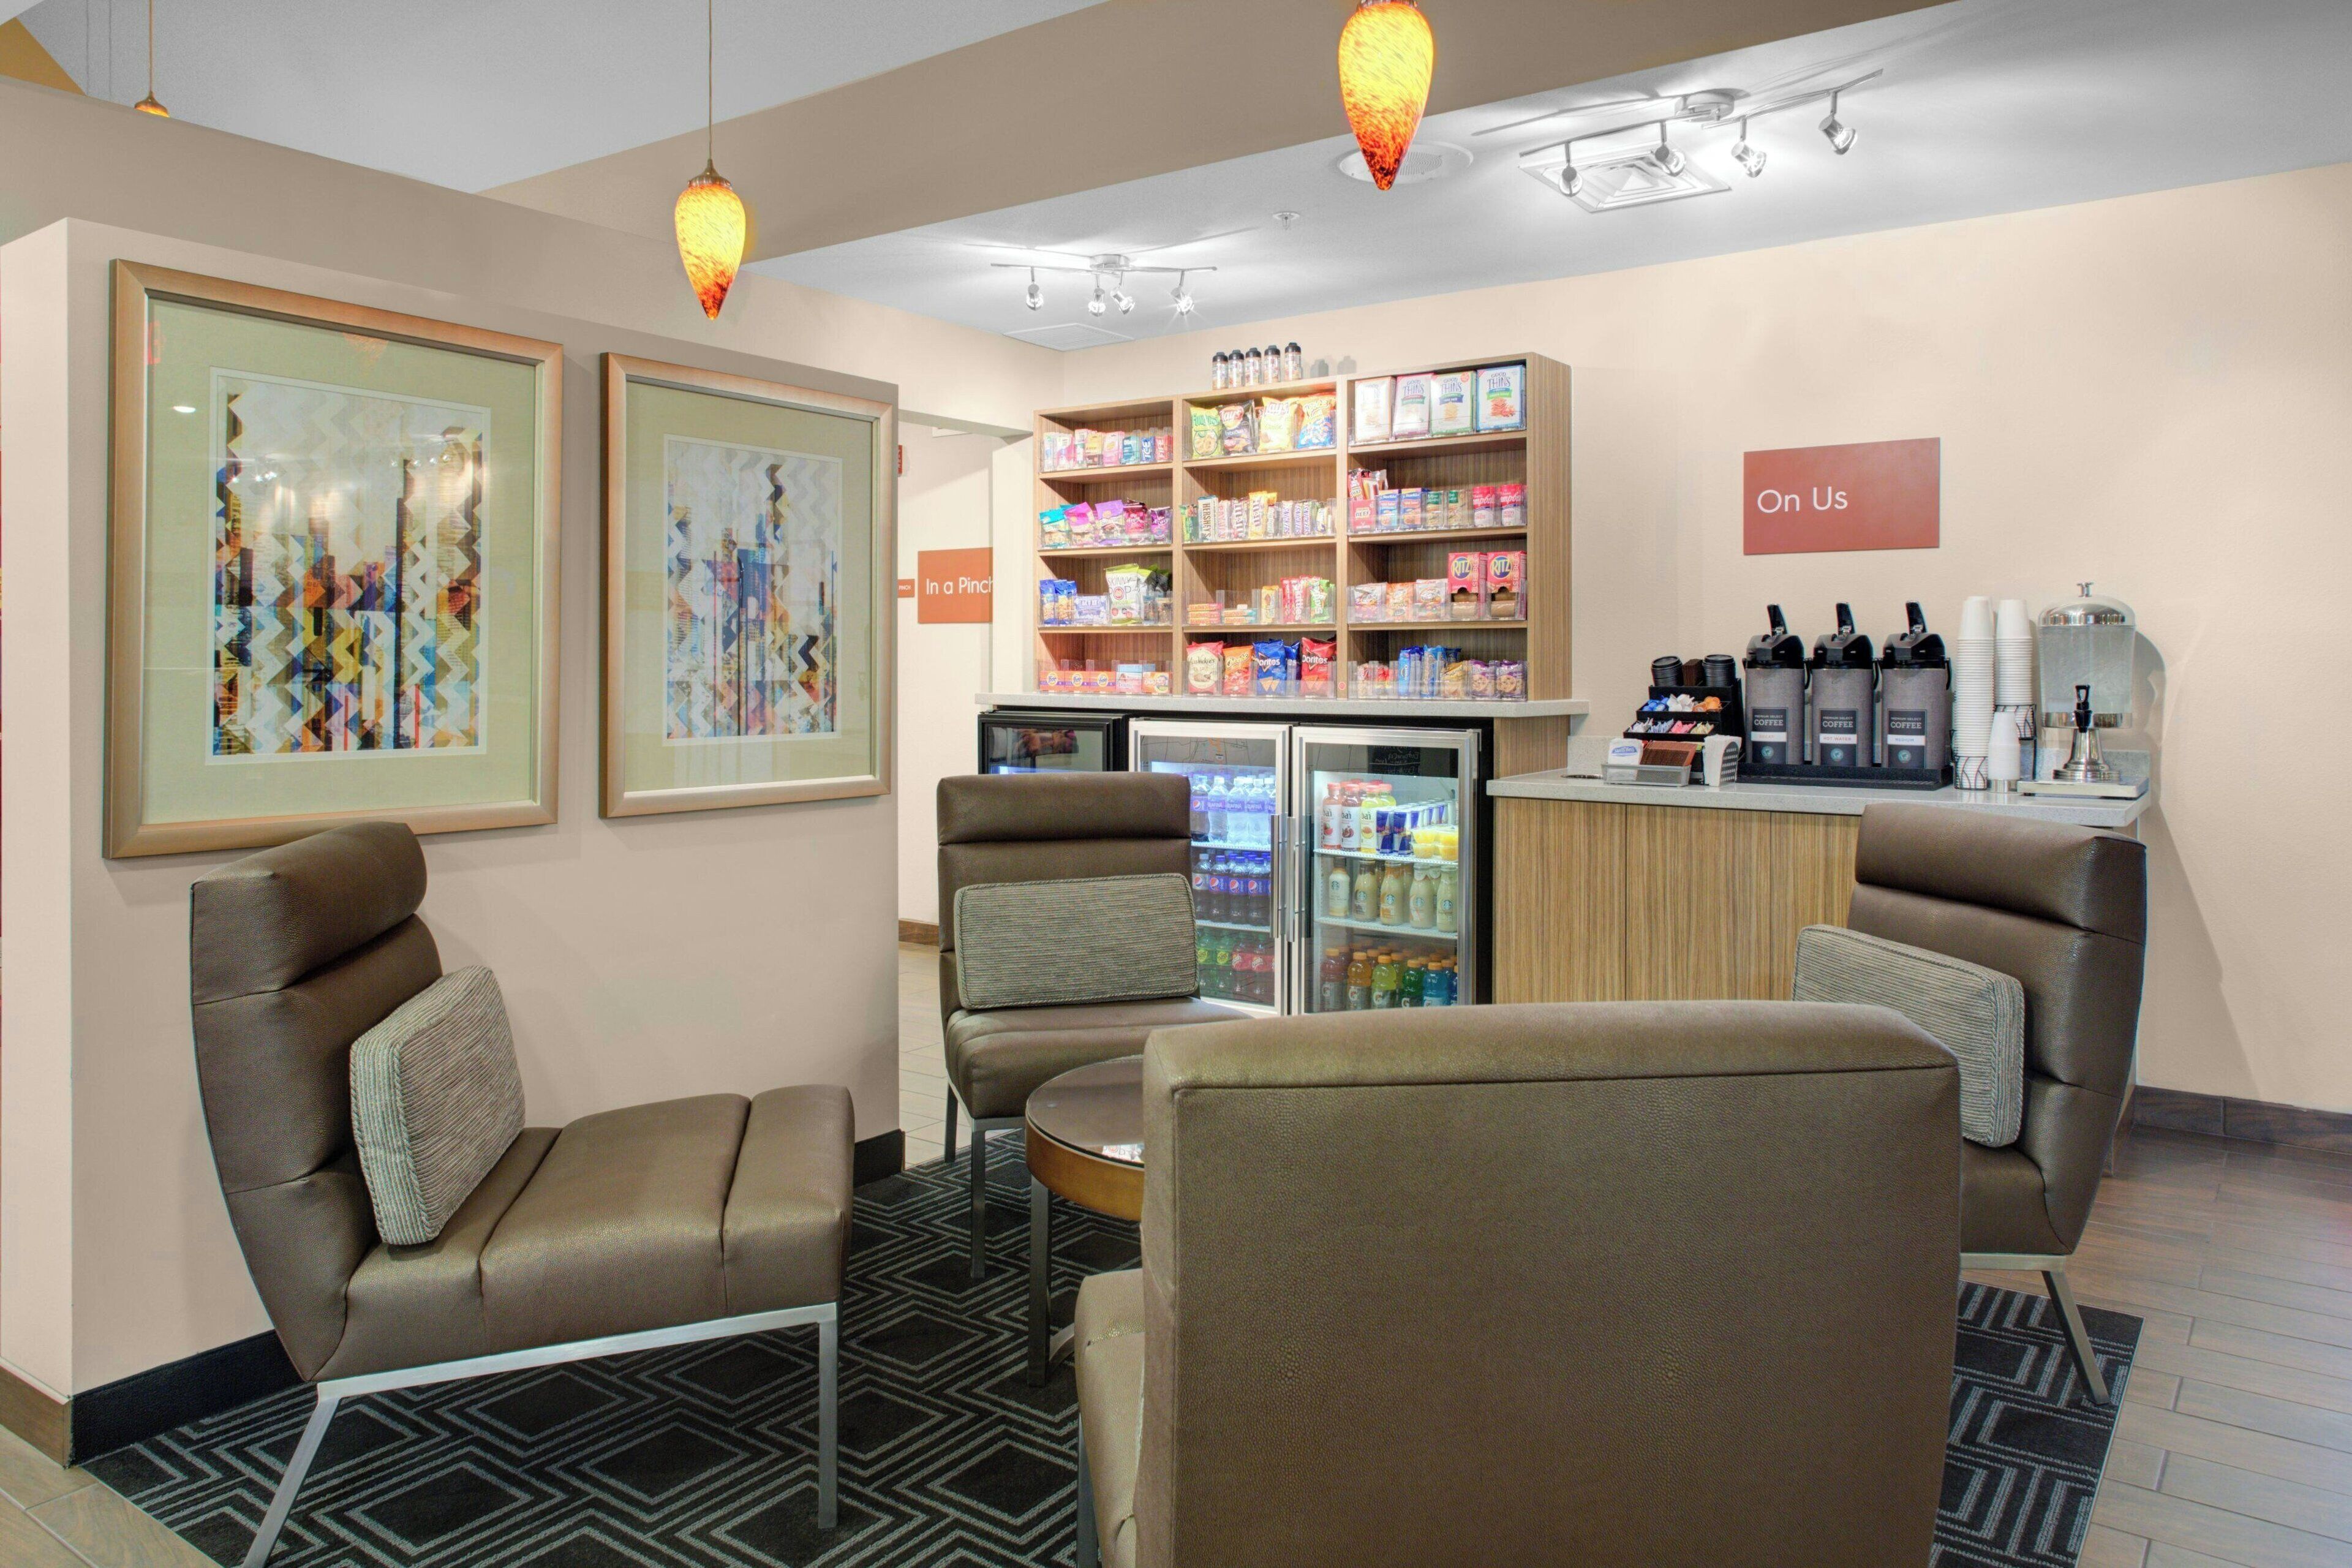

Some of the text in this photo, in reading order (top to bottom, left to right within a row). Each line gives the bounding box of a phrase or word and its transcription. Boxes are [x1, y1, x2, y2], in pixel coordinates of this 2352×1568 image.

[1403, 383, 1425, 397] THINS
[1441, 382, 1463, 393] THINS
[1487, 376, 1510, 390] THINS
[1757, 486, 1849, 513] On Us
[1452, 559, 1470, 576] RITZ
[1491, 559, 1510, 576] RITZ
[926, 578, 939, 595] In
[943, 581, 953, 595] a
[1302, 654, 1328, 664] Doritos
